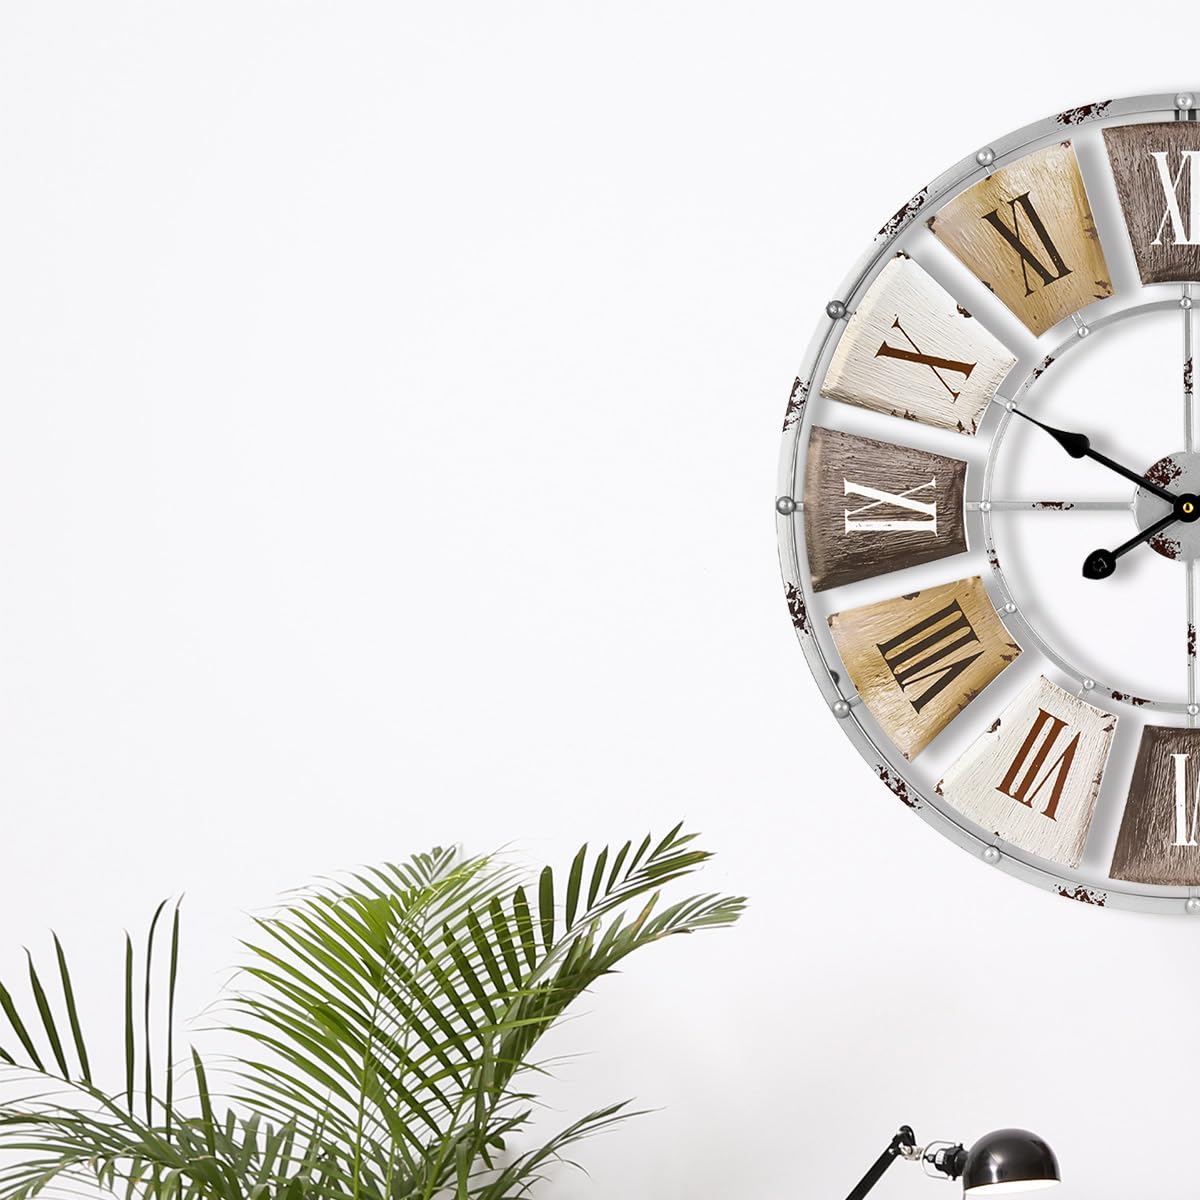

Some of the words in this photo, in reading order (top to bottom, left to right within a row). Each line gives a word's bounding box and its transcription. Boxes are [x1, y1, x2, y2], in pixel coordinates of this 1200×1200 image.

[981, 190, 1073, 299] XI
[874, 316, 977, 403] X
[844, 476, 938, 537] IX
[876, 598, 985, 715] VIII
[995, 707, 1082, 822] VII
